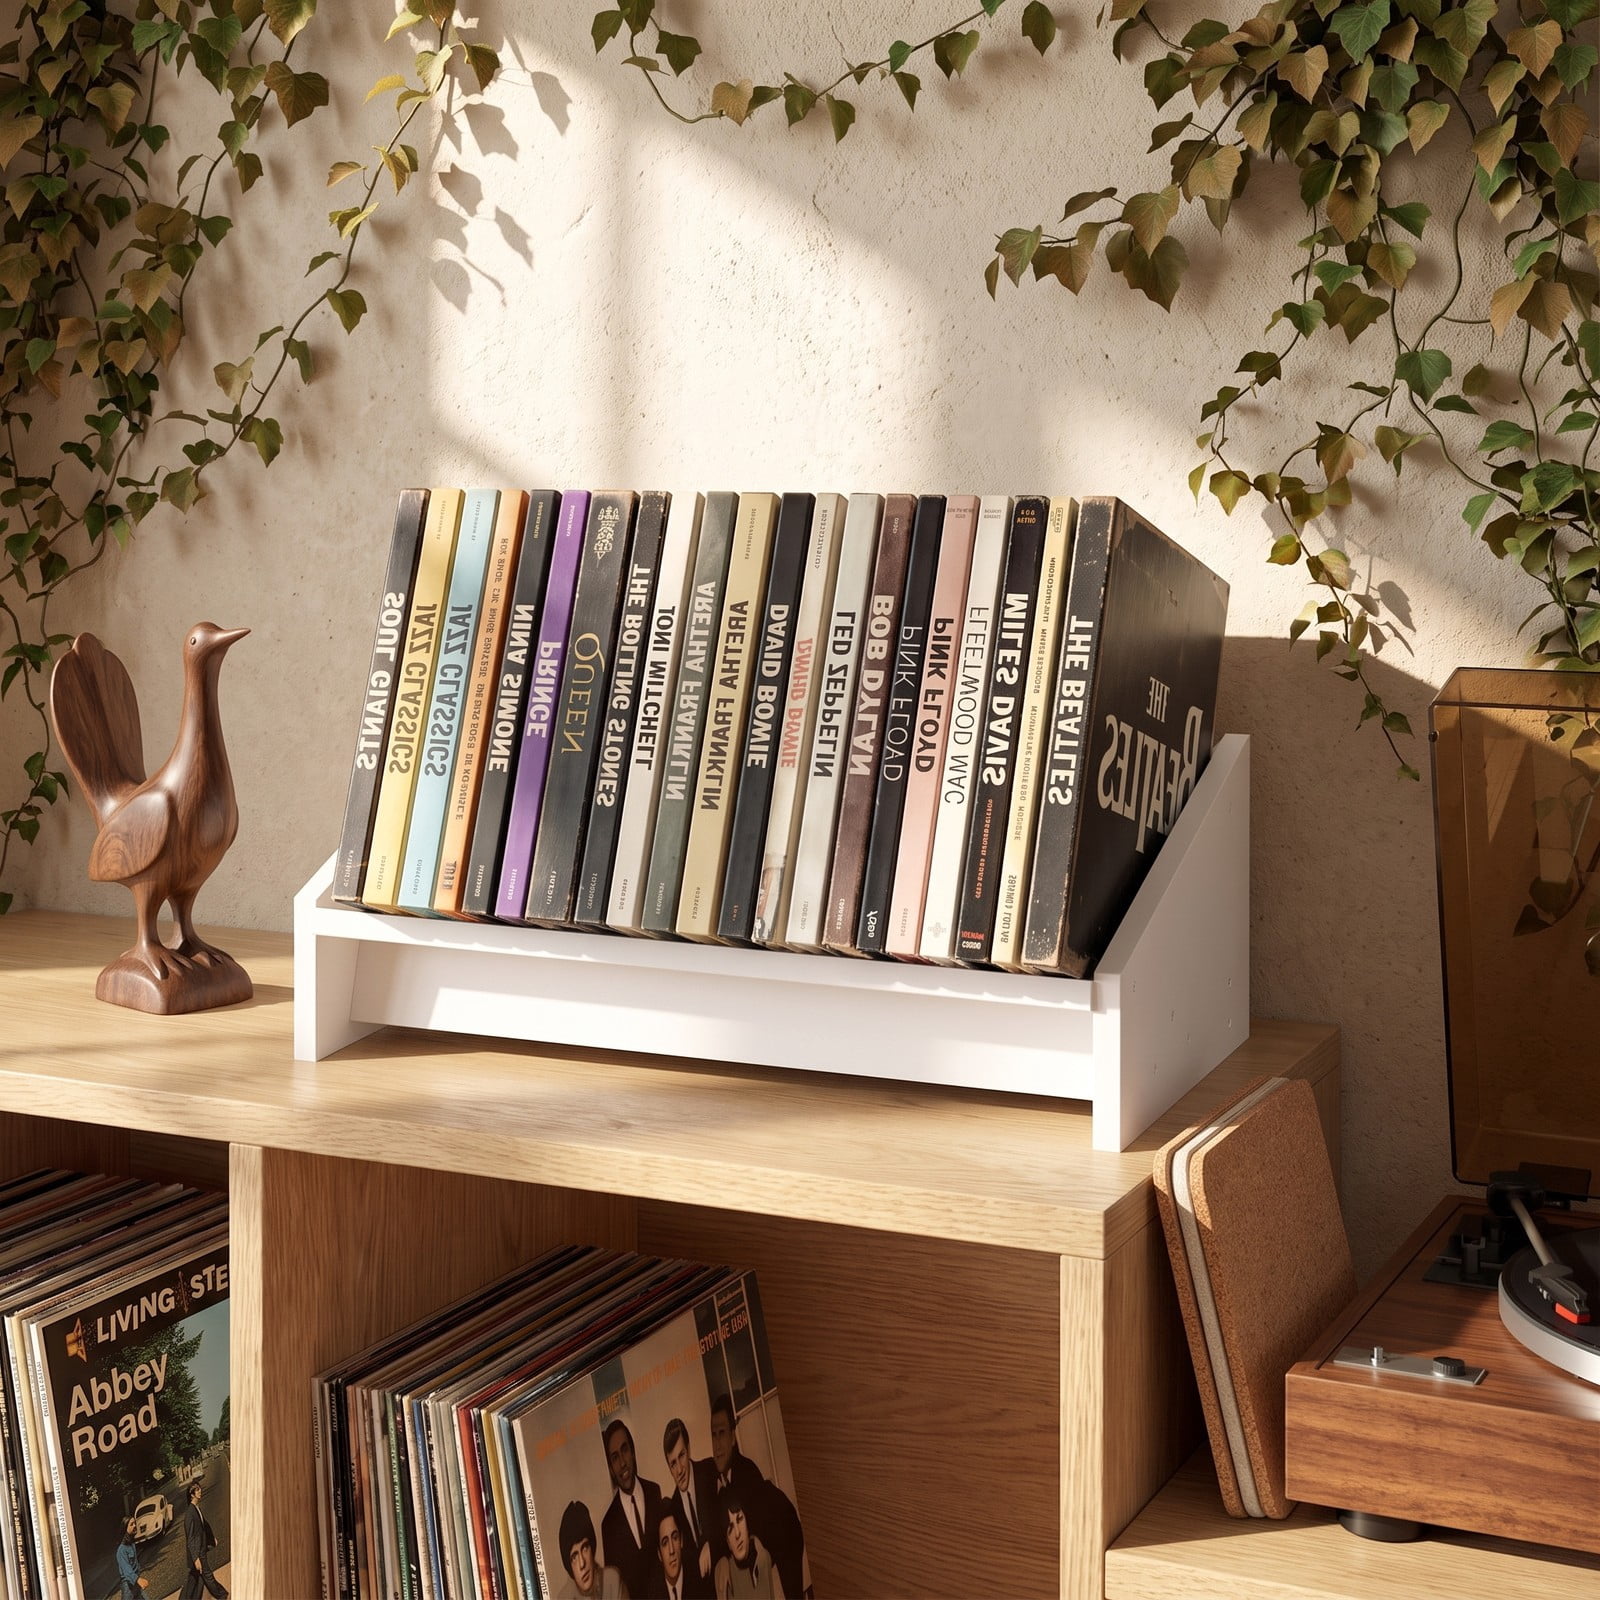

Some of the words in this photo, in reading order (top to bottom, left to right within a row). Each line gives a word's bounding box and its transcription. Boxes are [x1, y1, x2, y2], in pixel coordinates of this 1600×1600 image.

[96, 1288, 175, 1344] LIVING
[67, 1354, 168, 1428] Abbey
[71, 1393, 159, 1468] Road
